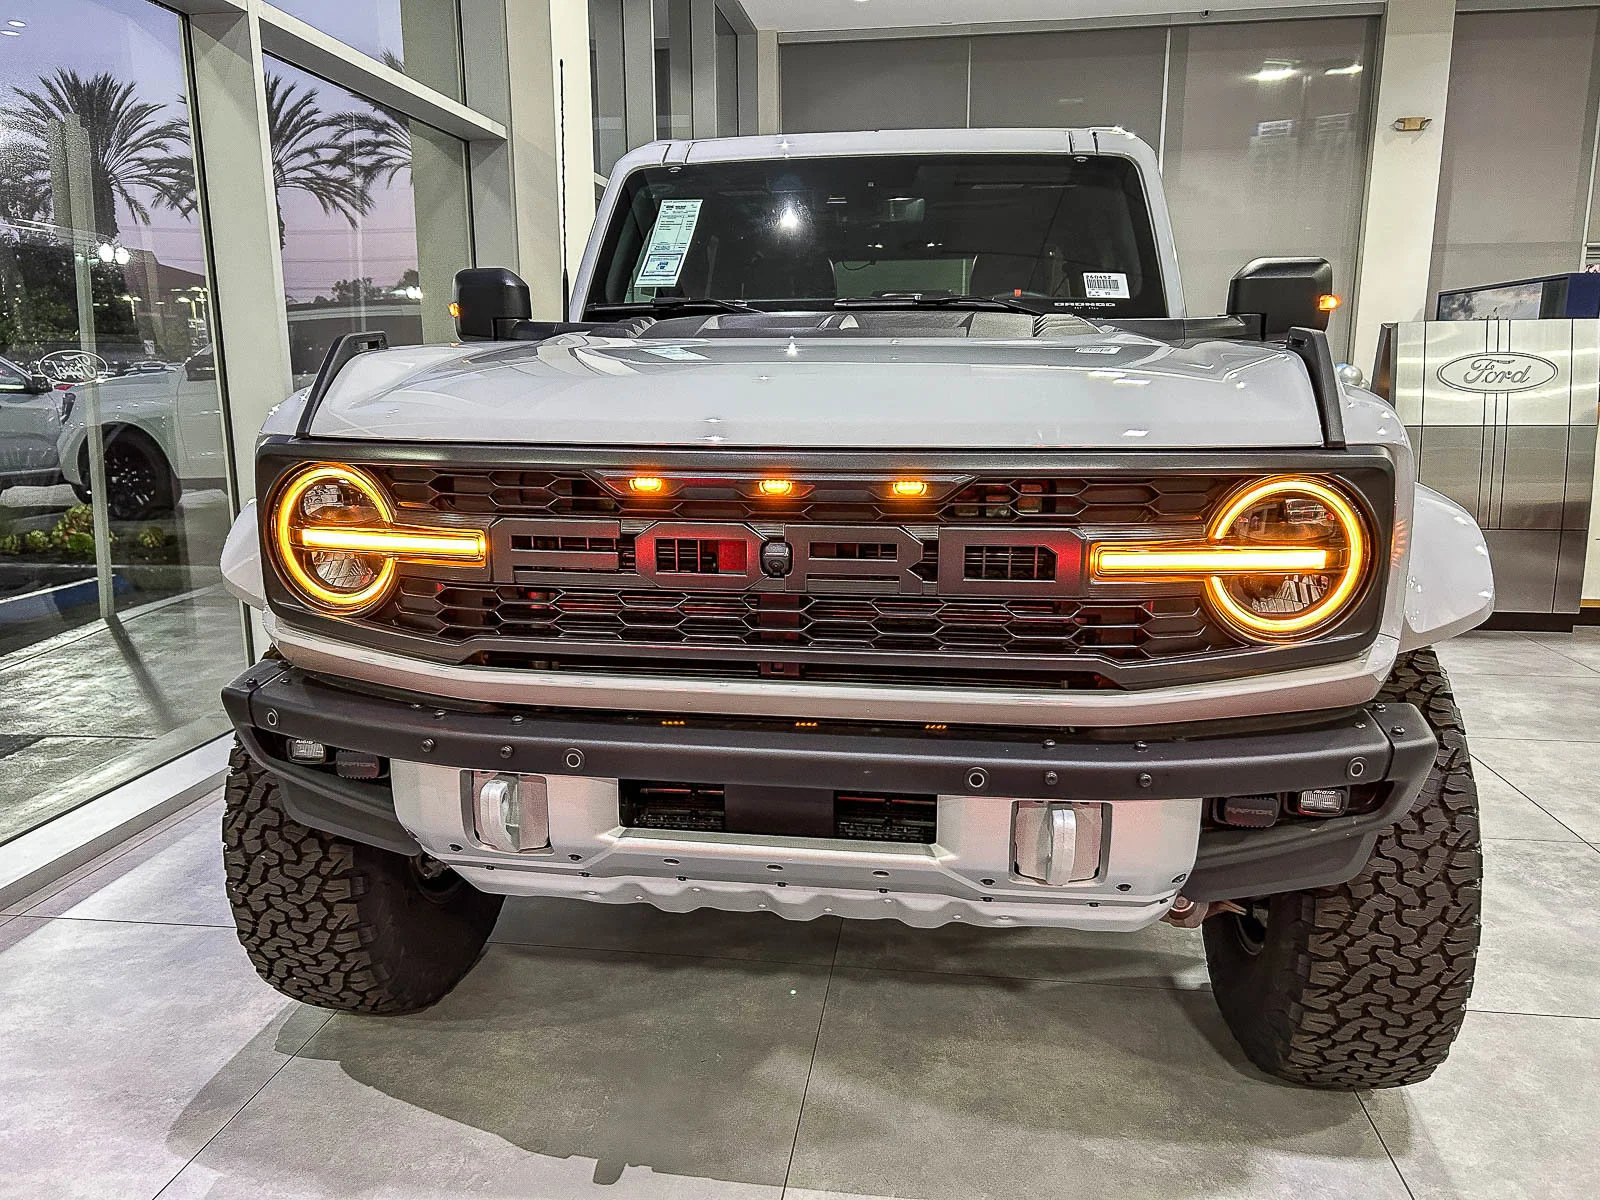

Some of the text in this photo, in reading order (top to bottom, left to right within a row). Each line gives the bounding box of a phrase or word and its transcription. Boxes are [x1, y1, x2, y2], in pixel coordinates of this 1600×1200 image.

[1463, 358, 1532, 384] Ford
[489, 518, 1083, 597] FORD
[1226, 806, 1274, 817] RAPTOR
